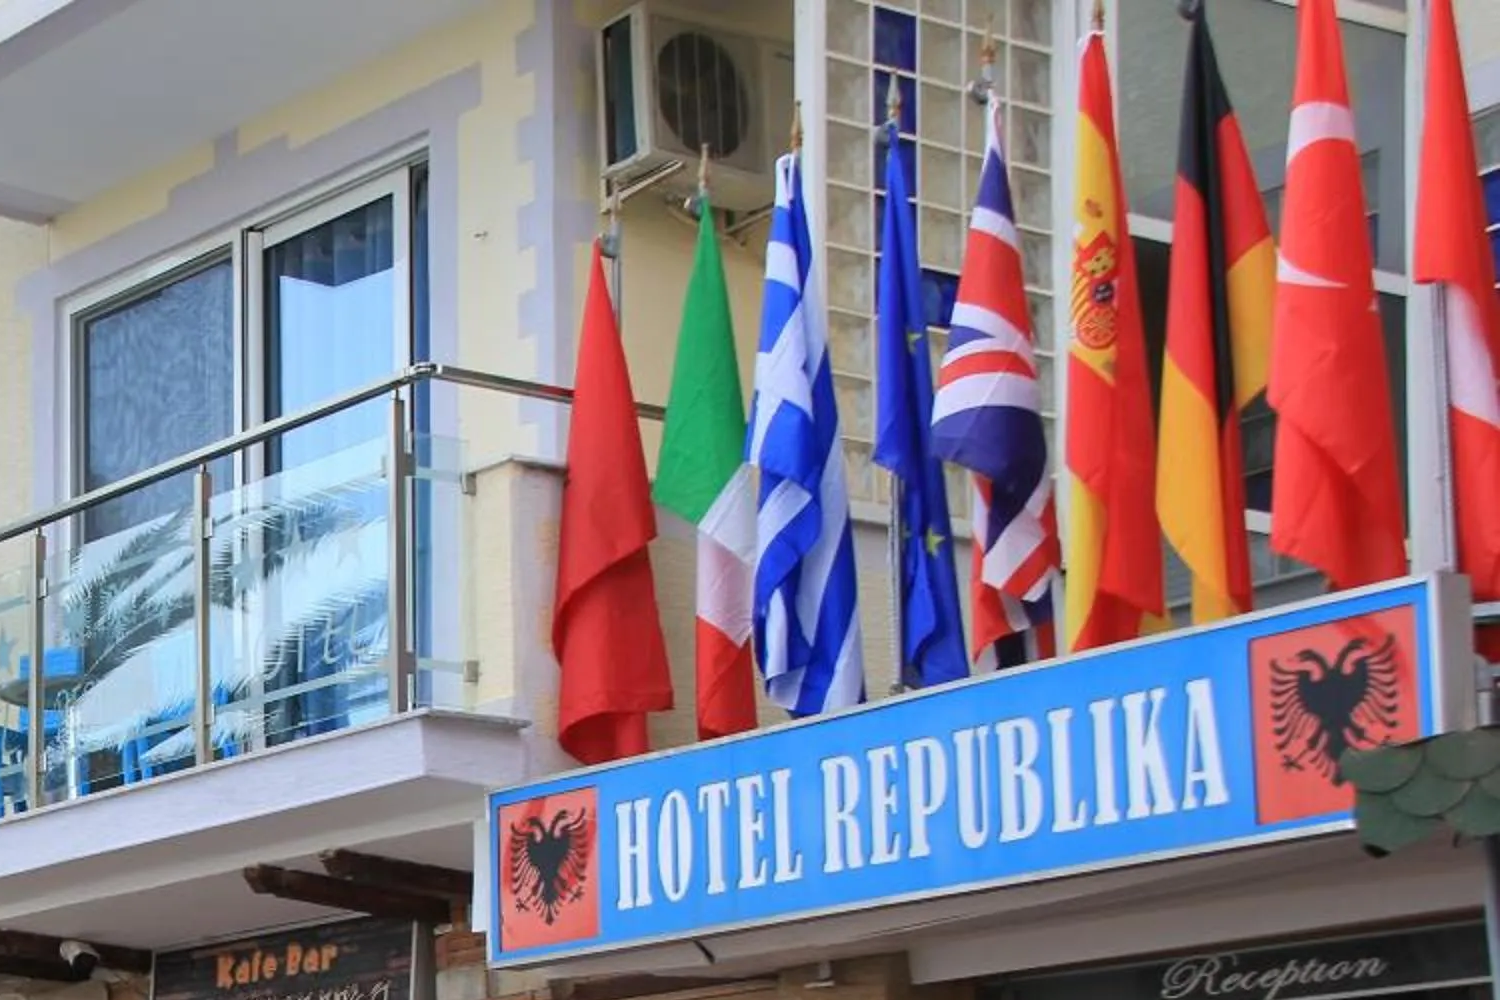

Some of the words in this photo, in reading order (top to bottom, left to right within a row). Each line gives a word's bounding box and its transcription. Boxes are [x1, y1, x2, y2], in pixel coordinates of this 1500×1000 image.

[614, 766, 803, 911] HOTEL
[819, 678, 1230, 874] REPUBLIKA
[215, 950, 278, 990] Kafe
[286, 941, 339, 977] Bar
